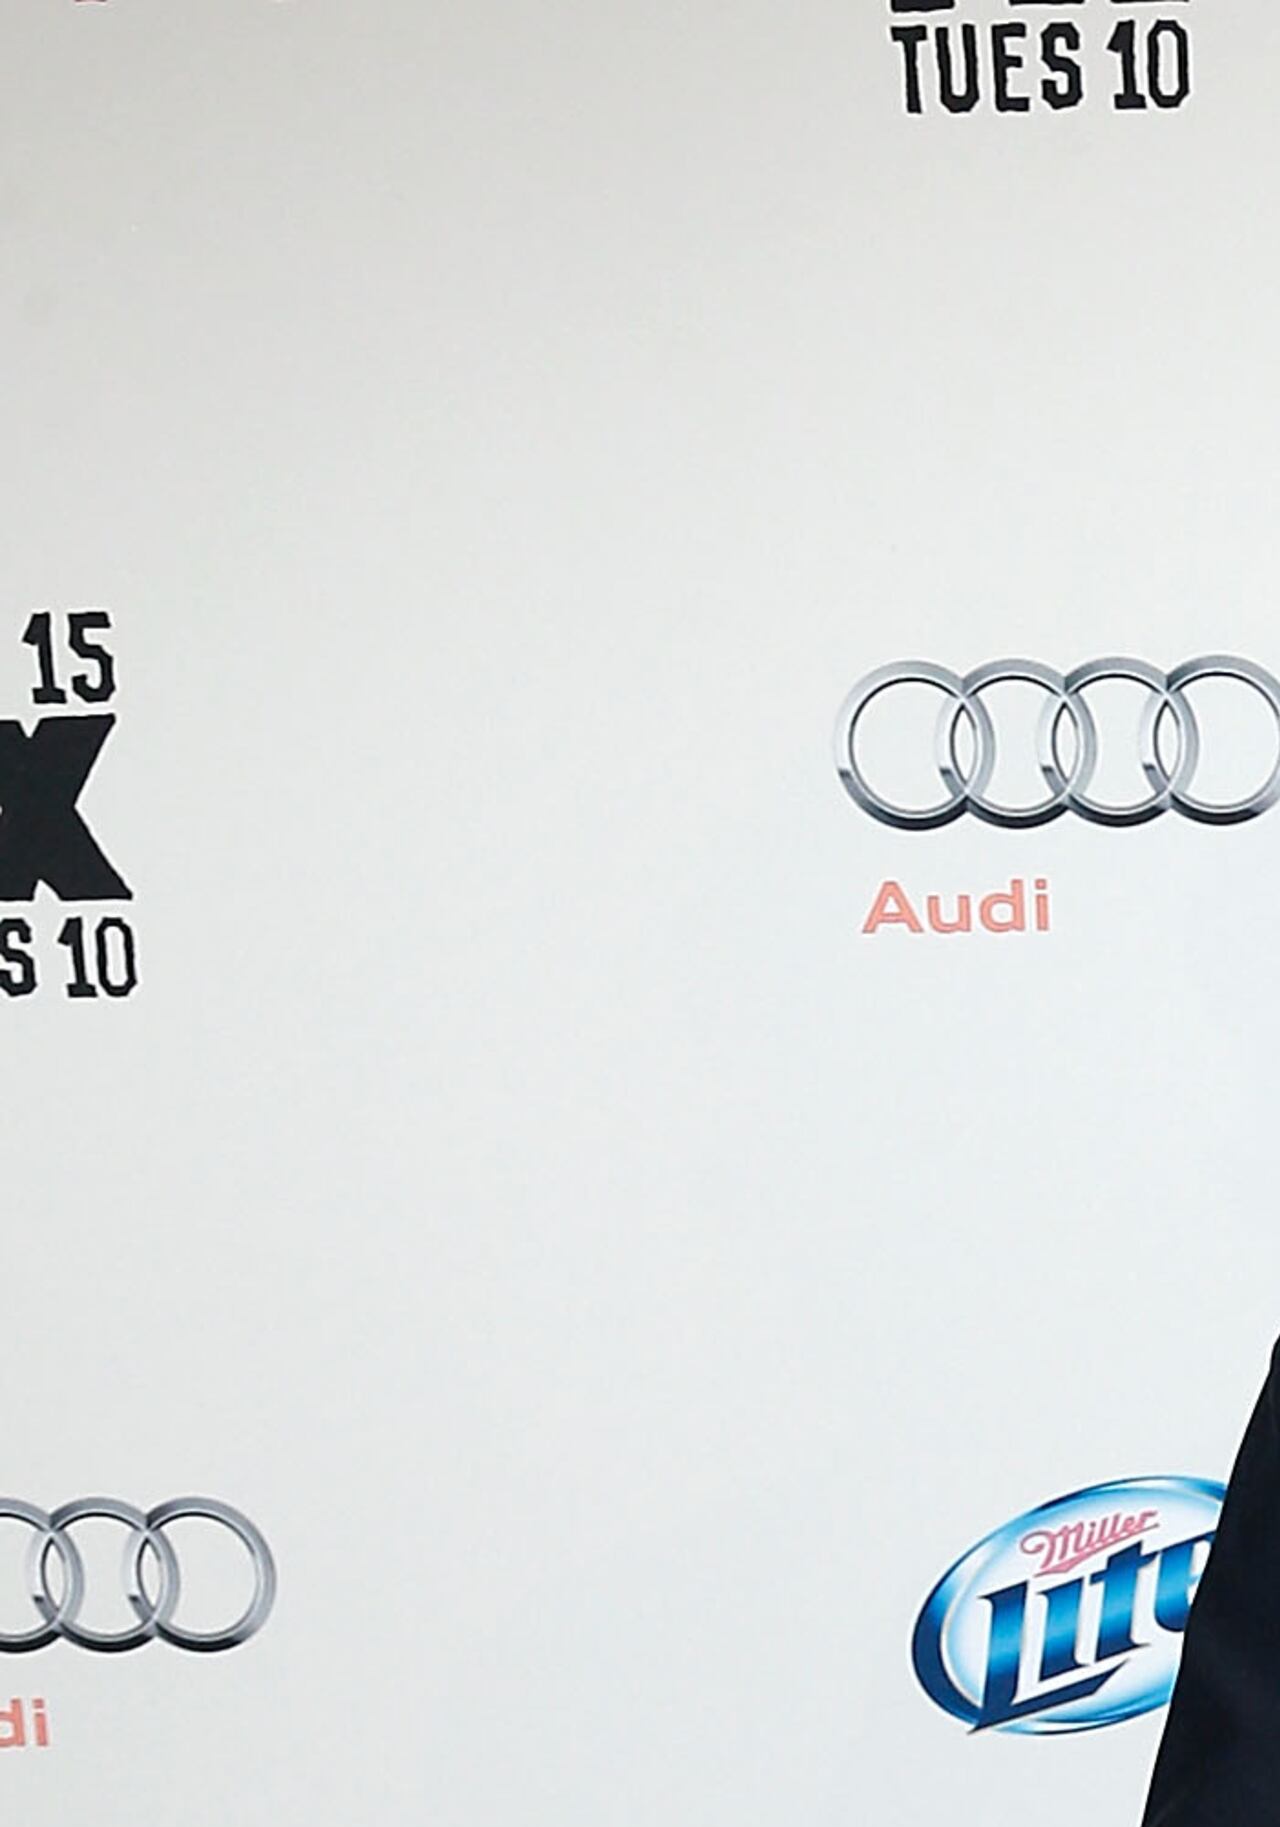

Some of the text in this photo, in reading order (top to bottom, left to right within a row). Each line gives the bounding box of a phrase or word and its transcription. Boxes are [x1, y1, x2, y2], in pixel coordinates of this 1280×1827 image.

[890, 19, 1191, 115] TUES 10
[21, 610, 117, 704] 15
[0, 713, 134, 902] X
[861, 878, 1052, 935] Audi
[57, 916, 138, 998] 10
[1020, 1510, 1160, 1579] Miller
